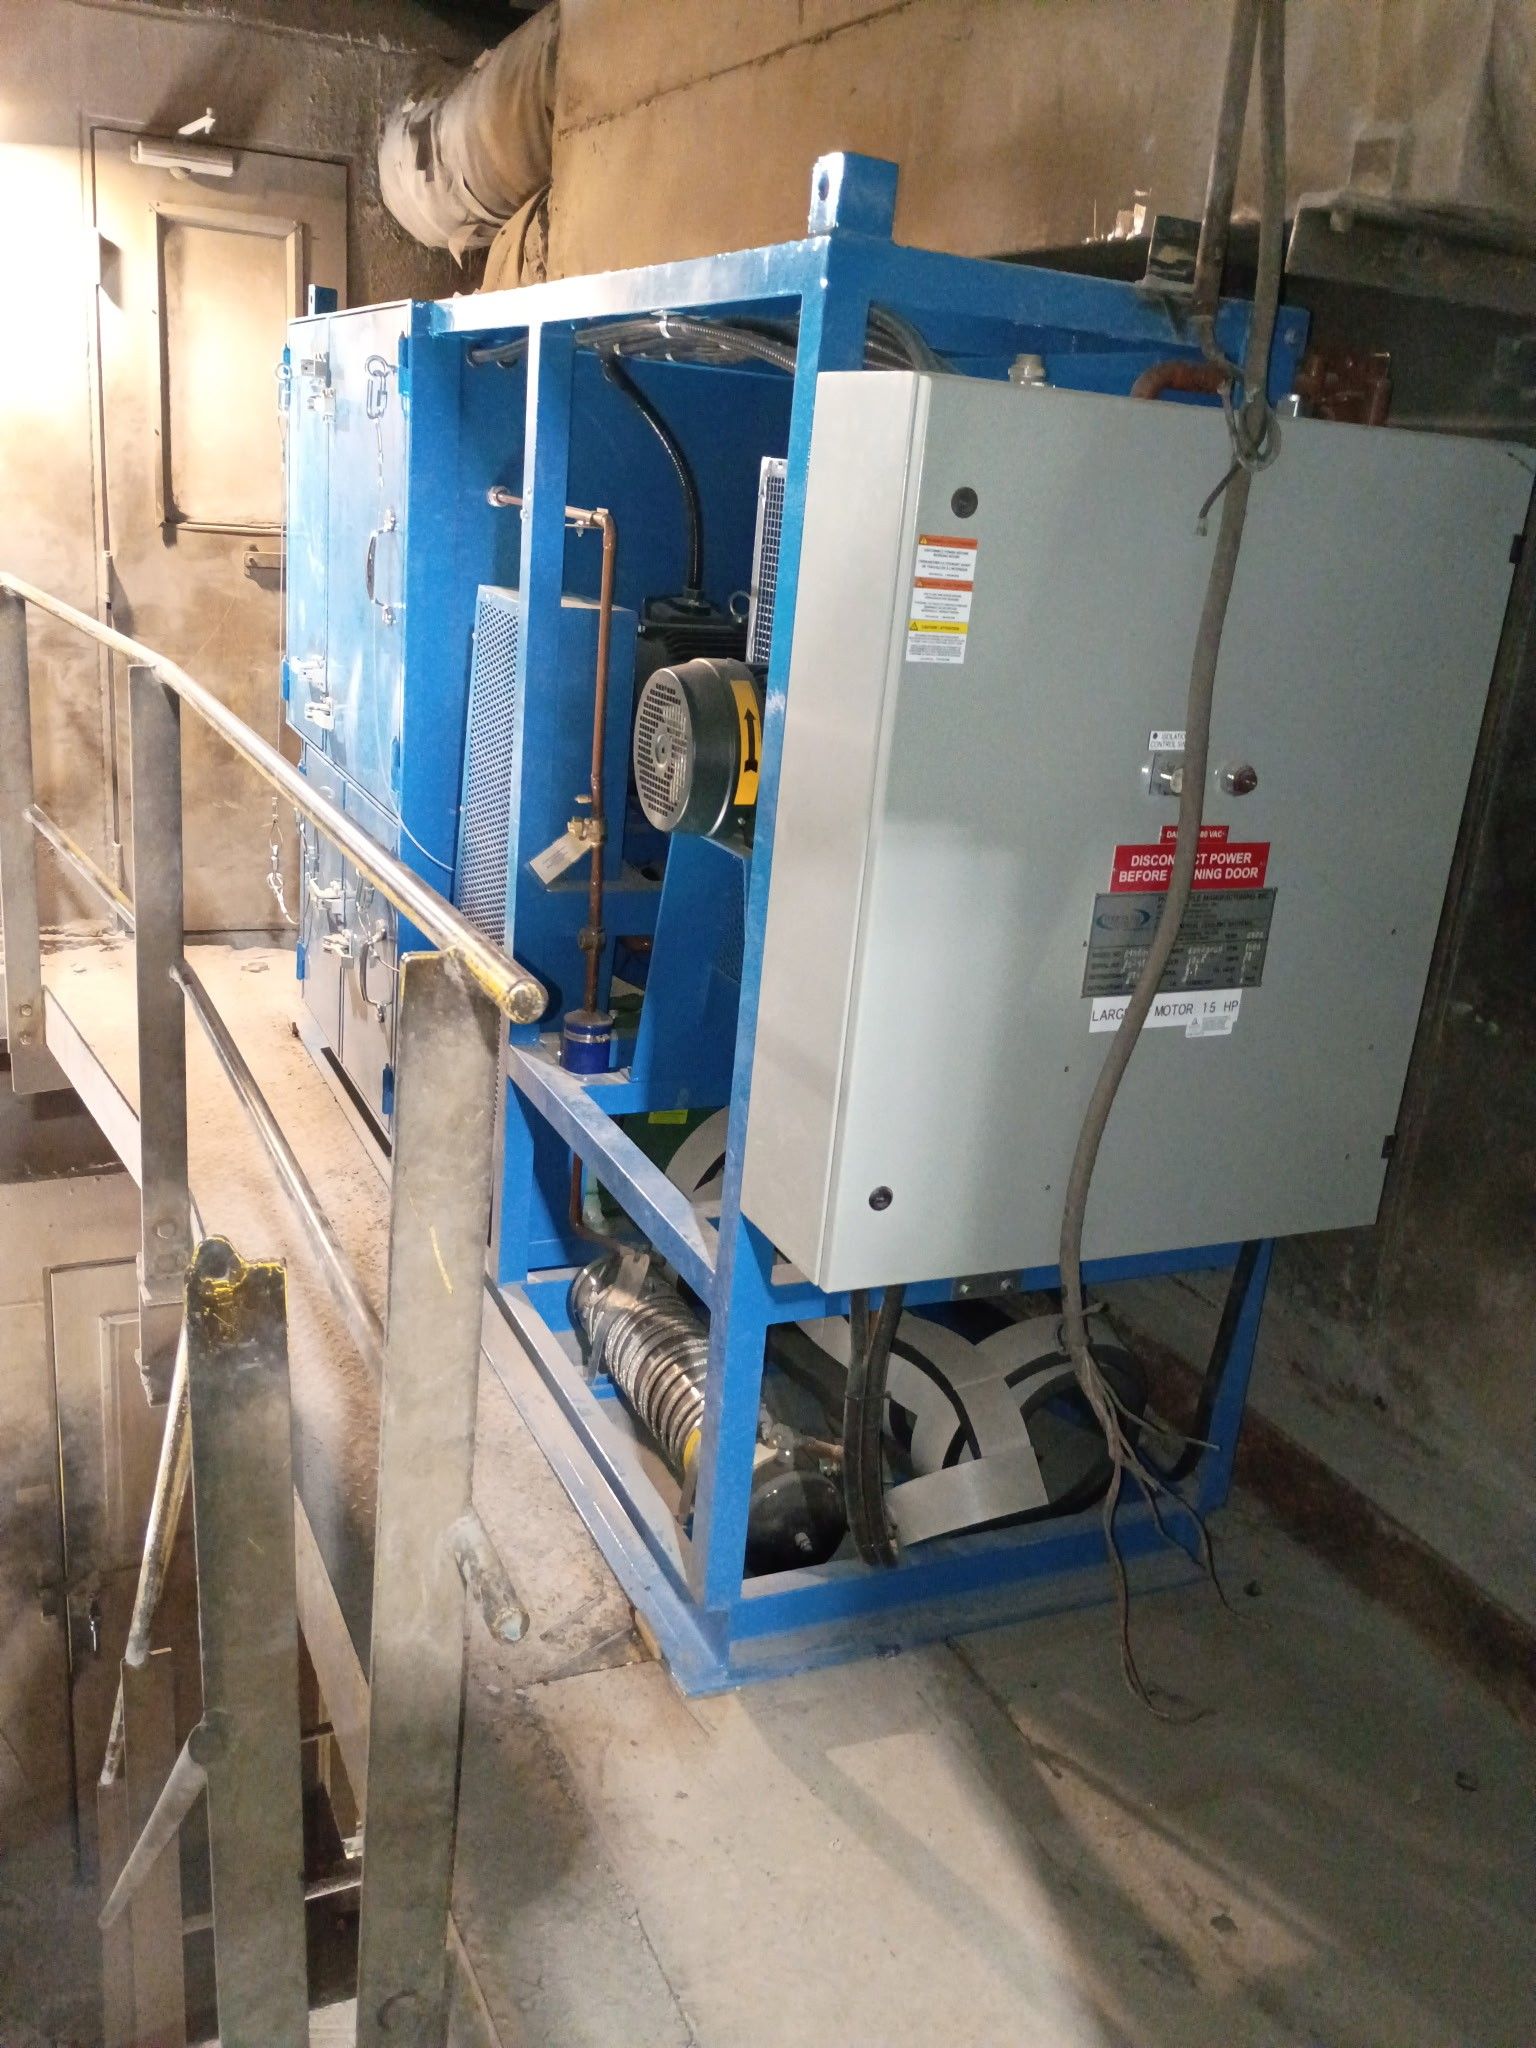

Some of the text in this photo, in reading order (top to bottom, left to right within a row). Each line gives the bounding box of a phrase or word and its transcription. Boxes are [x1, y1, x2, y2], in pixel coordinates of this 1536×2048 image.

[1208, 830, 1223, 838] VAC
[1131, 852, 1252, 867] DISCONT POWER
[1118, 869, 1167, 883] BEFORE
[1224, 866, 1259, 880] DOOR
[1154, 1003, 1194, 1017] MOTOR
[1223, 999, 1239, 1013] HP
